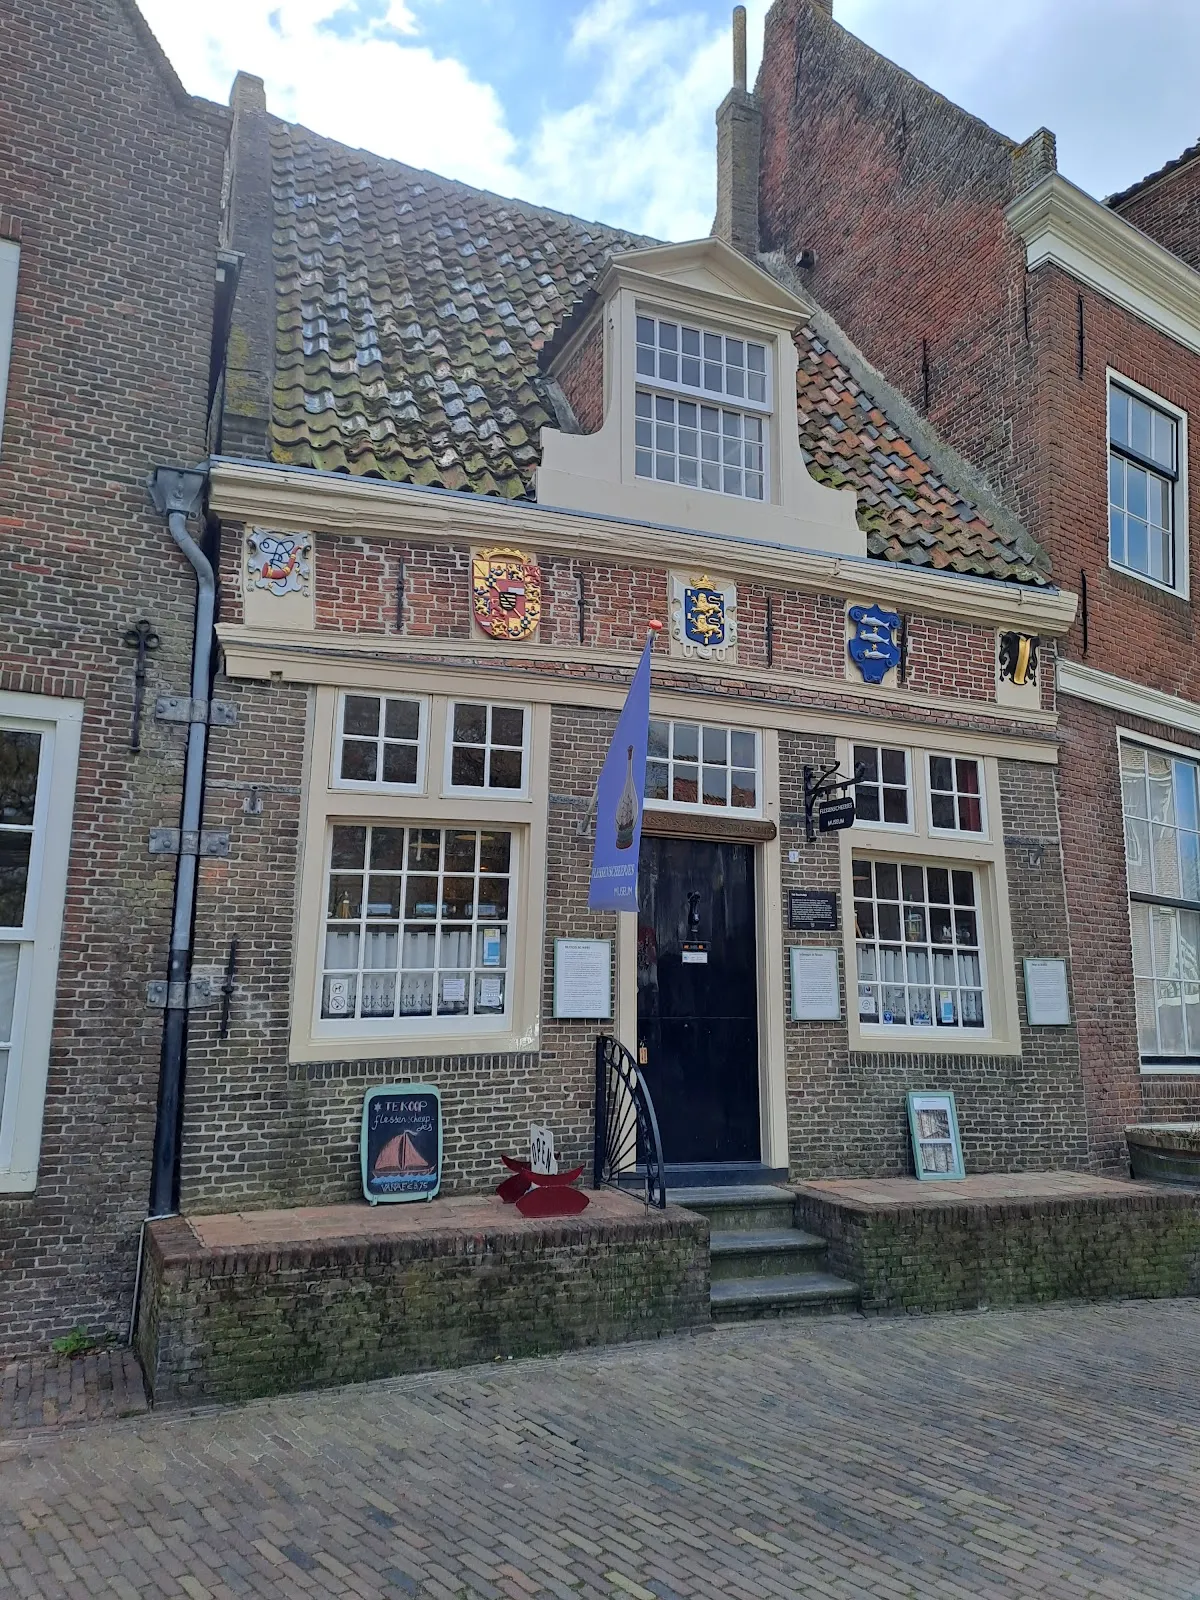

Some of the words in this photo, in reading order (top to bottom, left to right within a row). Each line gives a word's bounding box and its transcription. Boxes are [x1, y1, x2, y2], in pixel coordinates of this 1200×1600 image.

[386, 1101, 400, 1112] TE
[400, 1101, 428, 1112] KOOP
[531, 1137, 552, 1174] OPEN
